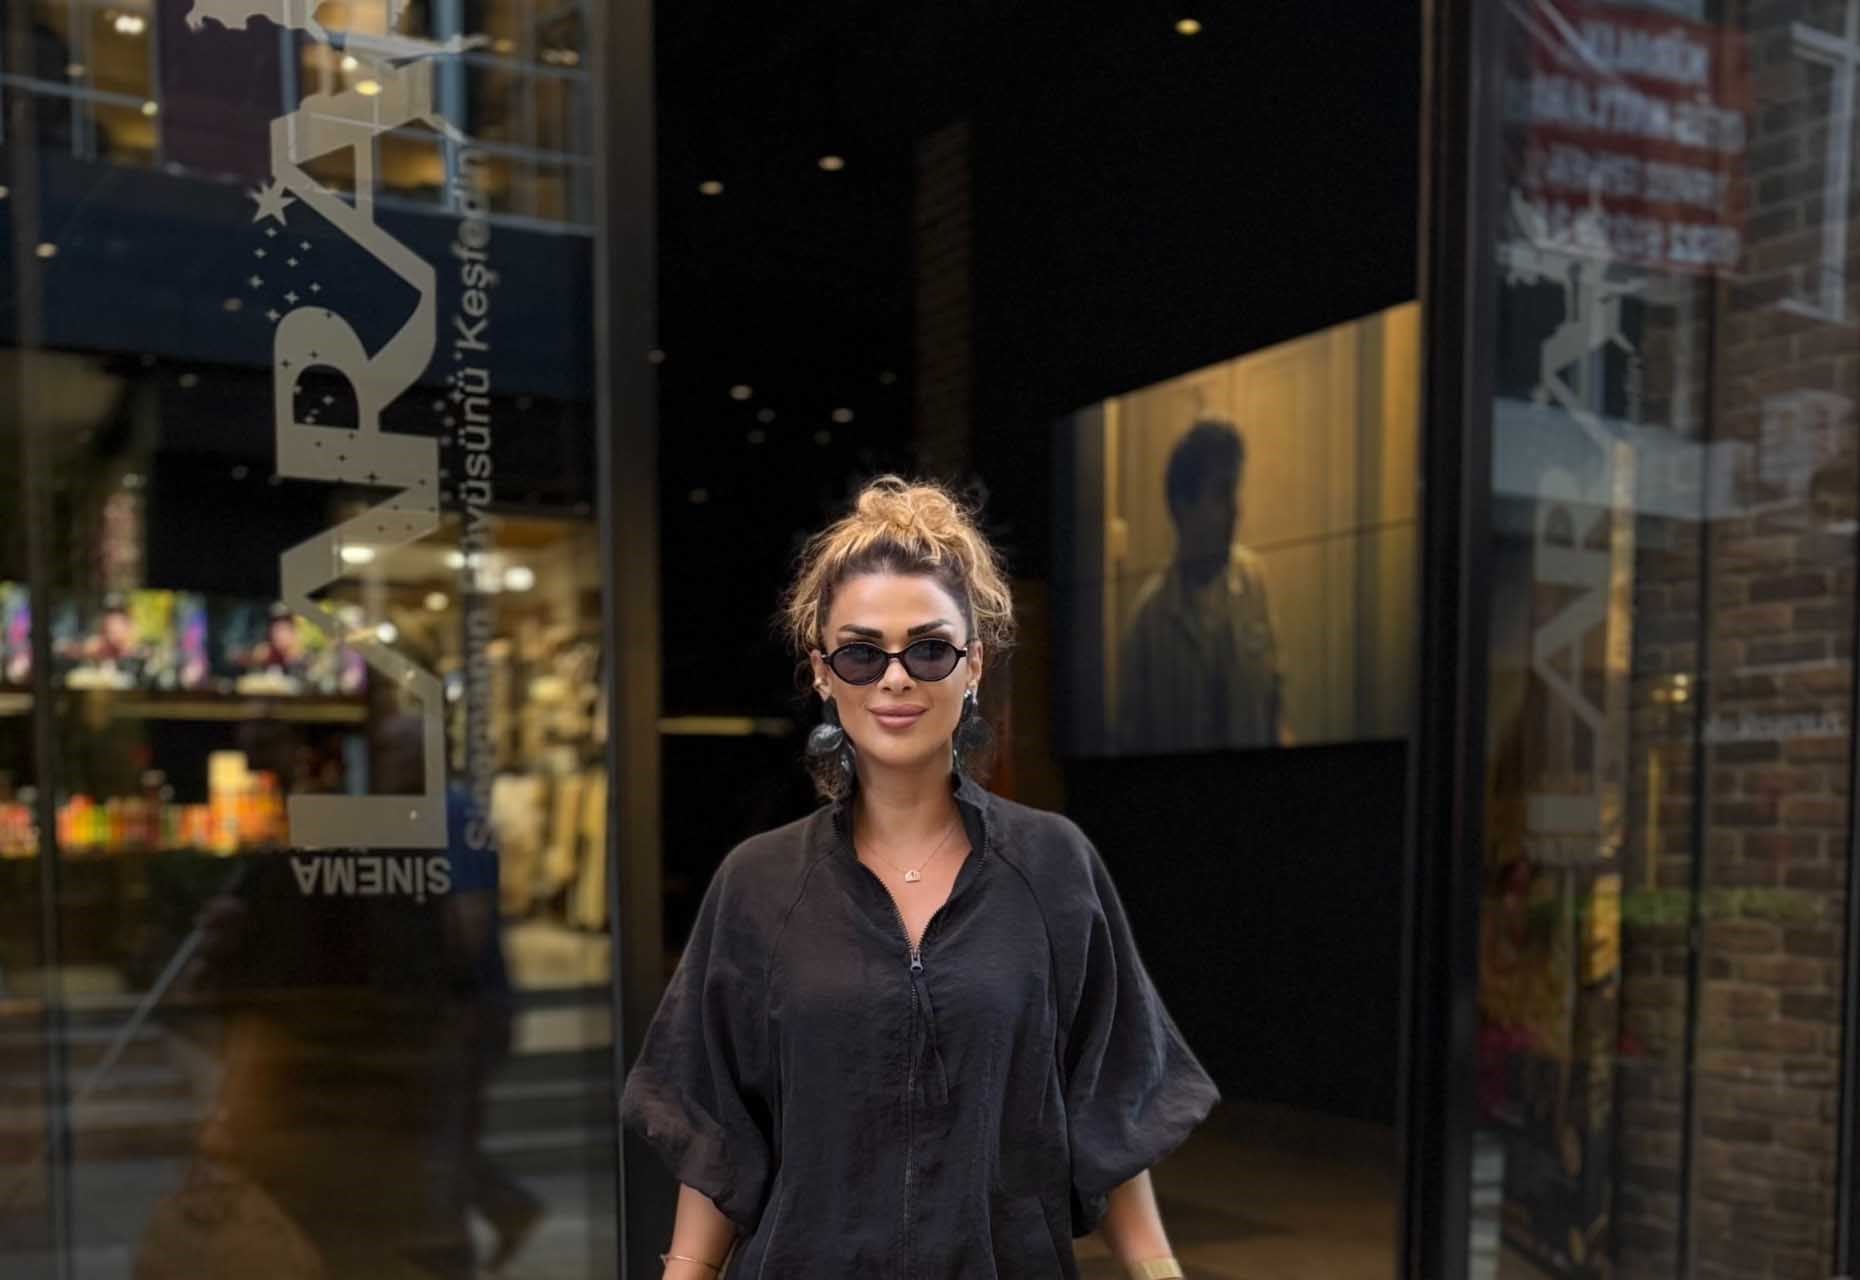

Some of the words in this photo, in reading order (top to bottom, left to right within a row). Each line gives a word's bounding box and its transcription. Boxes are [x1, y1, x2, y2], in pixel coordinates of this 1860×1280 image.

[270, 58, 449, 849] LARA
[456, 367, 494, 594] üyüsünü
[291, 856, 452, 903] SİNEMA
